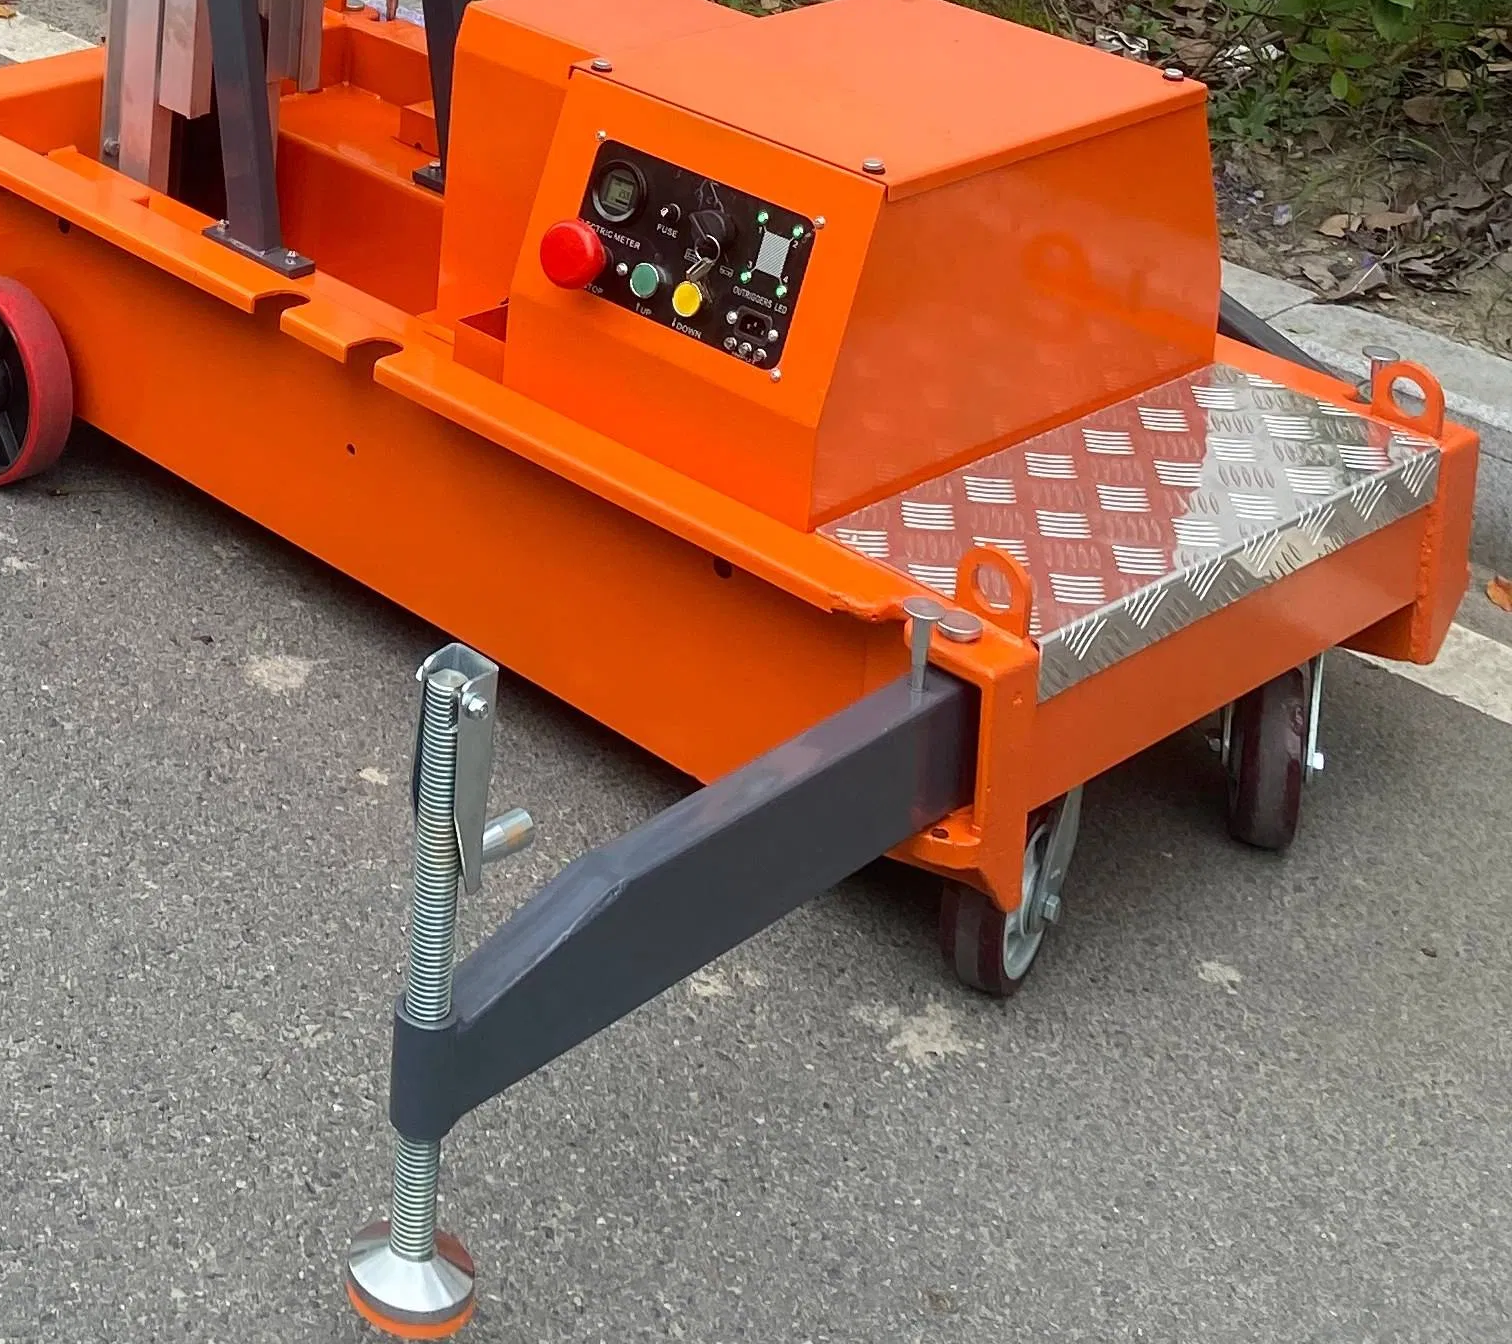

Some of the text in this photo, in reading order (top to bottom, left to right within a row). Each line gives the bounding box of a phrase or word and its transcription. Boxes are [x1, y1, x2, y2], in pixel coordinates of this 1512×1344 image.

[656, 223, 679, 239] FUSE
[613, 232, 641, 250] METER
[792, 240, 799, 249] 2
[782, 275, 789, 283] 4
[732, 285, 788, 315] OUTRIGGERS LED
[640, 307, 652, 316] UP
[675, 322, 702, 339] DOWN
